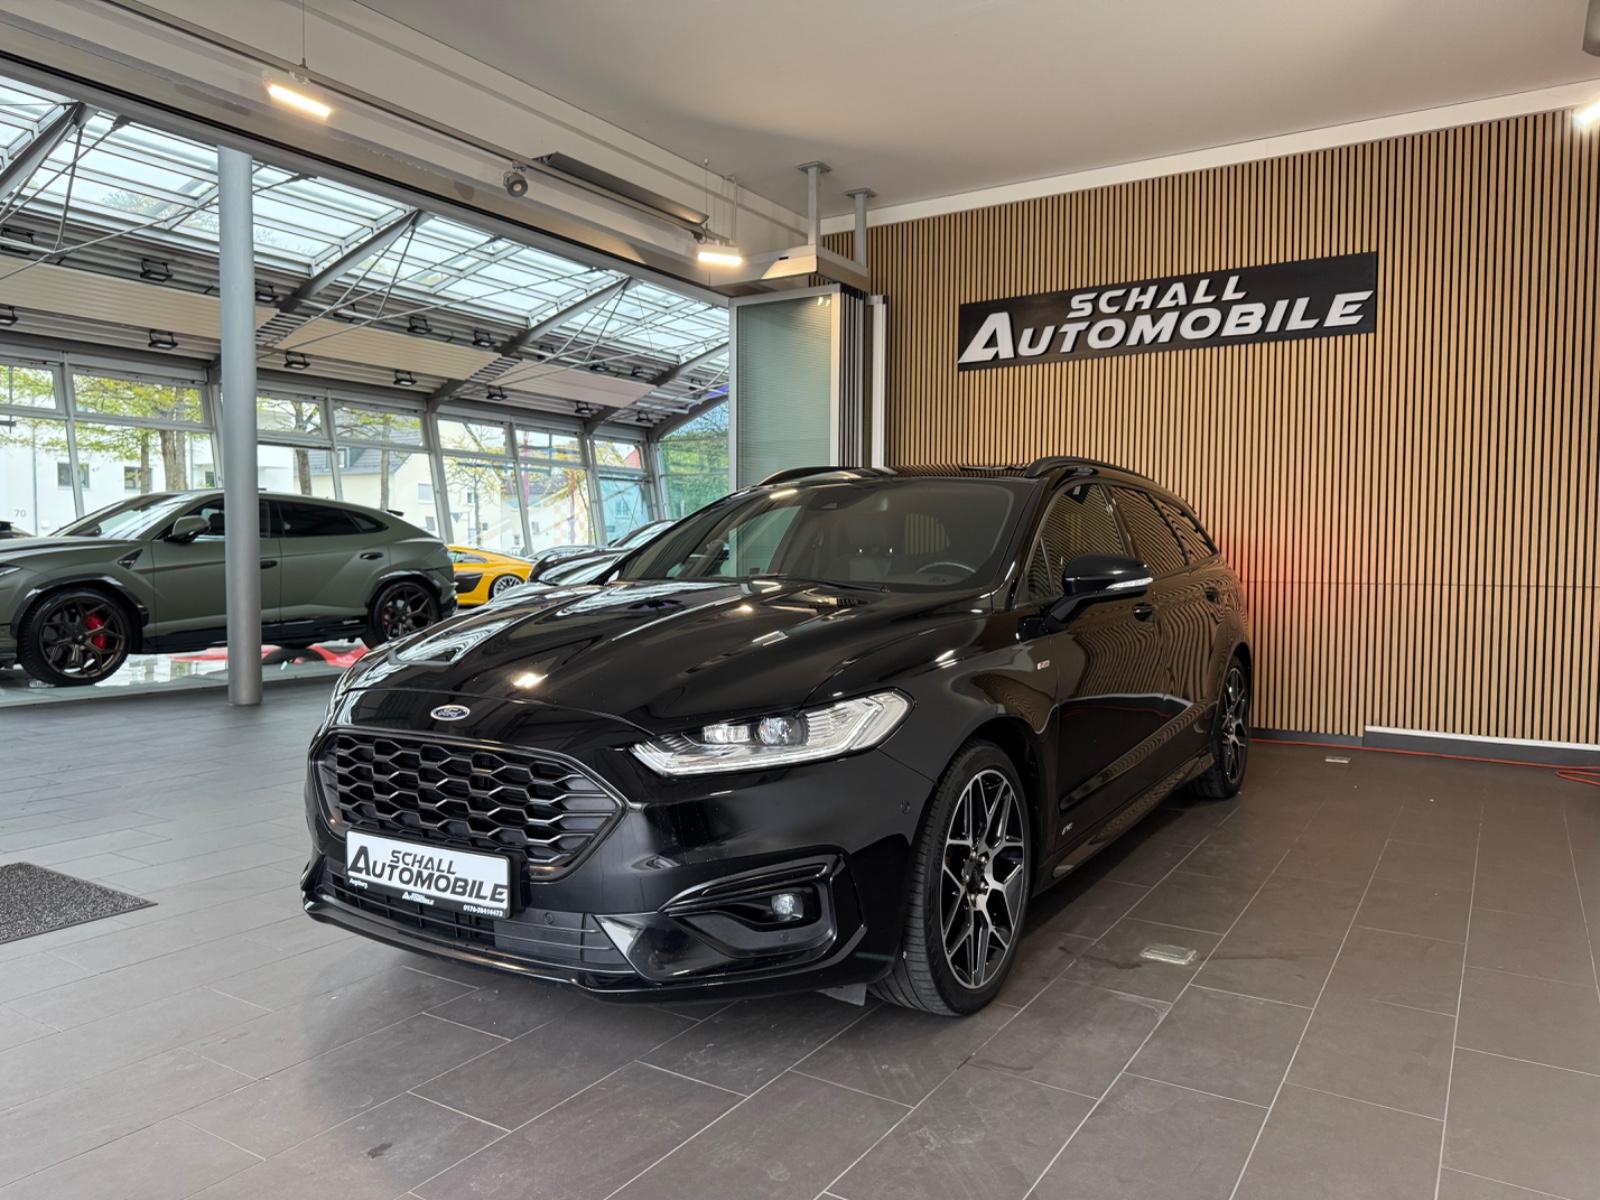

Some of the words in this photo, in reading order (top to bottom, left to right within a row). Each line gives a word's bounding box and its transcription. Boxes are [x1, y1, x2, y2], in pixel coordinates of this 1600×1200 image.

[1067, 275, 1249, 319] SCHALL
[958, 290, 1374, 364] AUTOMOBILE
[14, 509, 27, 518] 70
[348, 845, 508, 903] AUTOMOBILE
[390, 850, 457, 876] SCHALL
